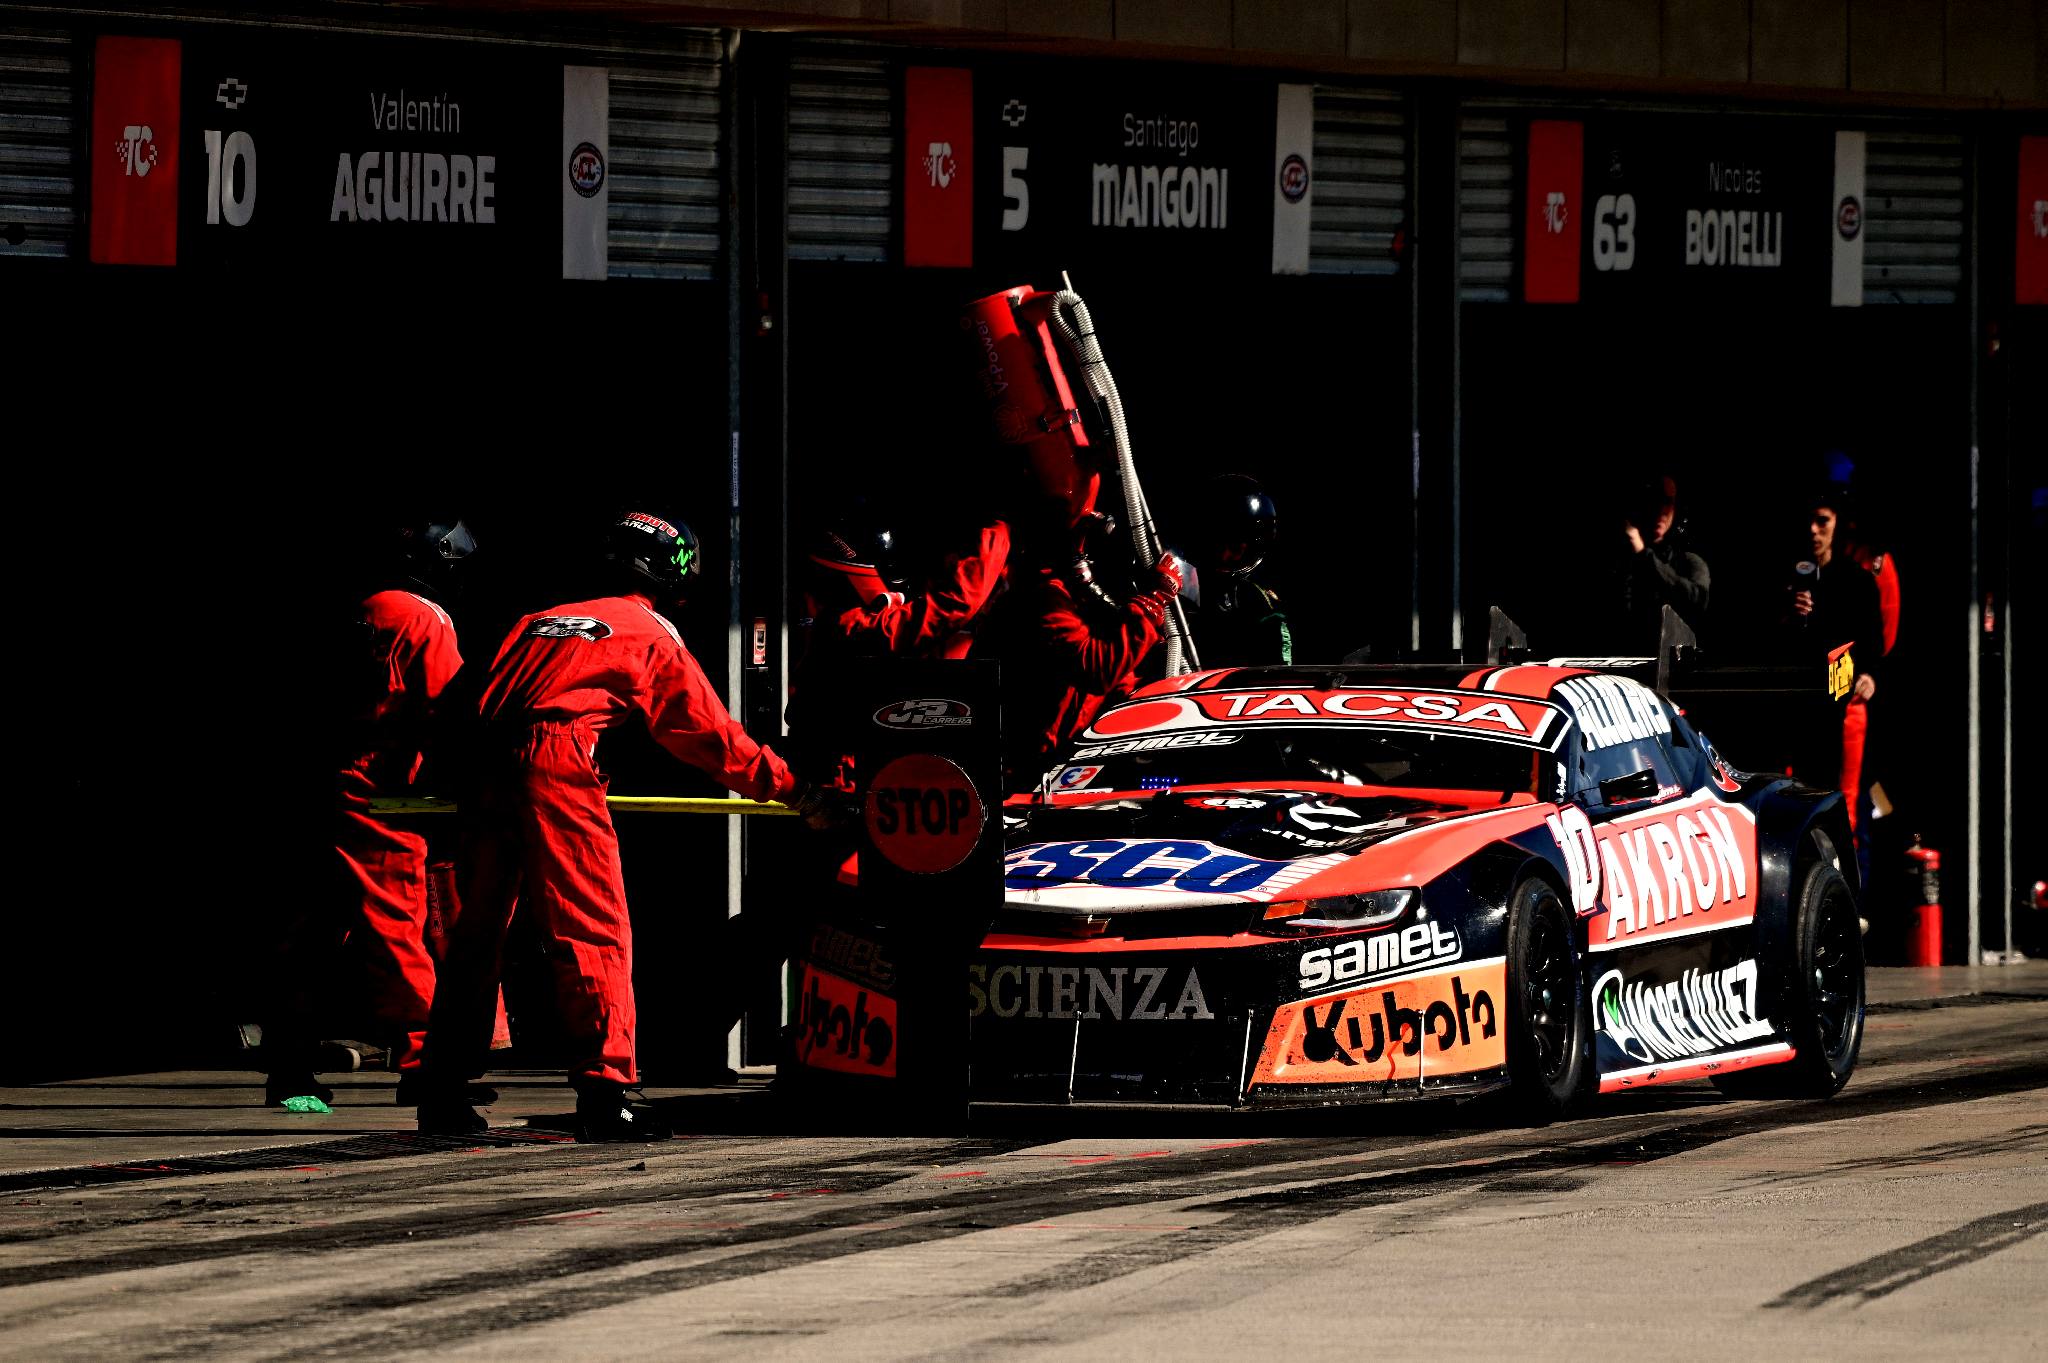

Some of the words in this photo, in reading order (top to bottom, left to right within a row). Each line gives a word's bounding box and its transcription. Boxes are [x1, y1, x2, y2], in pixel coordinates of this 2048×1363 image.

[370, 89, 462, 133] Valentín
[1123, 113, 1200, 156] Santiago
[204, 130, 257, 227] 10
[330, 151, 497, 224] AGUIRRE
[1001, 145, 1030, 231] 5
[1090, 161, 1228, 229] MANGONI
[1592, 192, 1637, 271] 63
[1684, 208, 1783, 267] BONELLI
[922, 716, 972, 726] CARRERA
[1073, 732, 1236, 760] samet
[1219, 693, 1533, 732] TACSA
[877, 787, 969, 835] STOP
[1545, 805, 1601, 915] 10
[1599, 806, 1747, 941] AKRON
[1299, 921, 1459, 988] samet
[967, 964, 1216, 1021] SCIENZA
[1303, 976, 1497, 1066] Kubota
